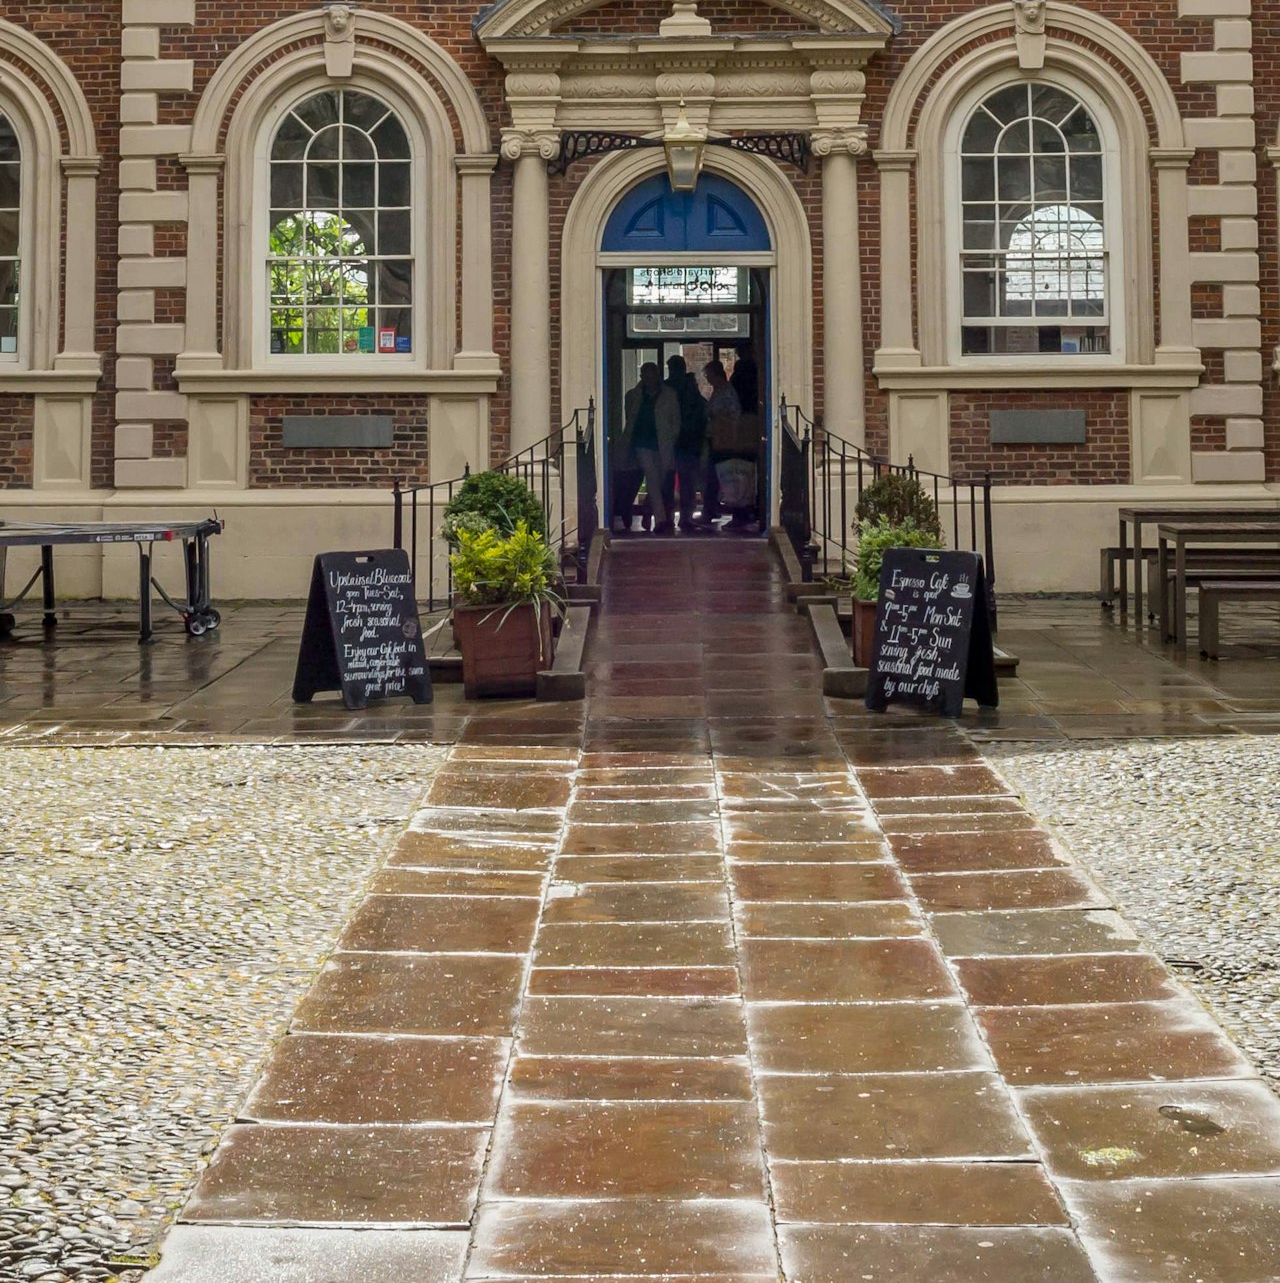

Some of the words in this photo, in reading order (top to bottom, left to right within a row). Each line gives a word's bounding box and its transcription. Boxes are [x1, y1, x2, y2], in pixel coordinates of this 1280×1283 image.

[329, 571, 366, 594] Upstairs
[374, 568, 412, 586] Bluecoat
[891, 569, 925, 591] Espresso
[929, 626, 952, 649] Sun
[935, 661, 960, 681] made
[883, 677, 896, 697] by
[898, 681, 918, 693] our
